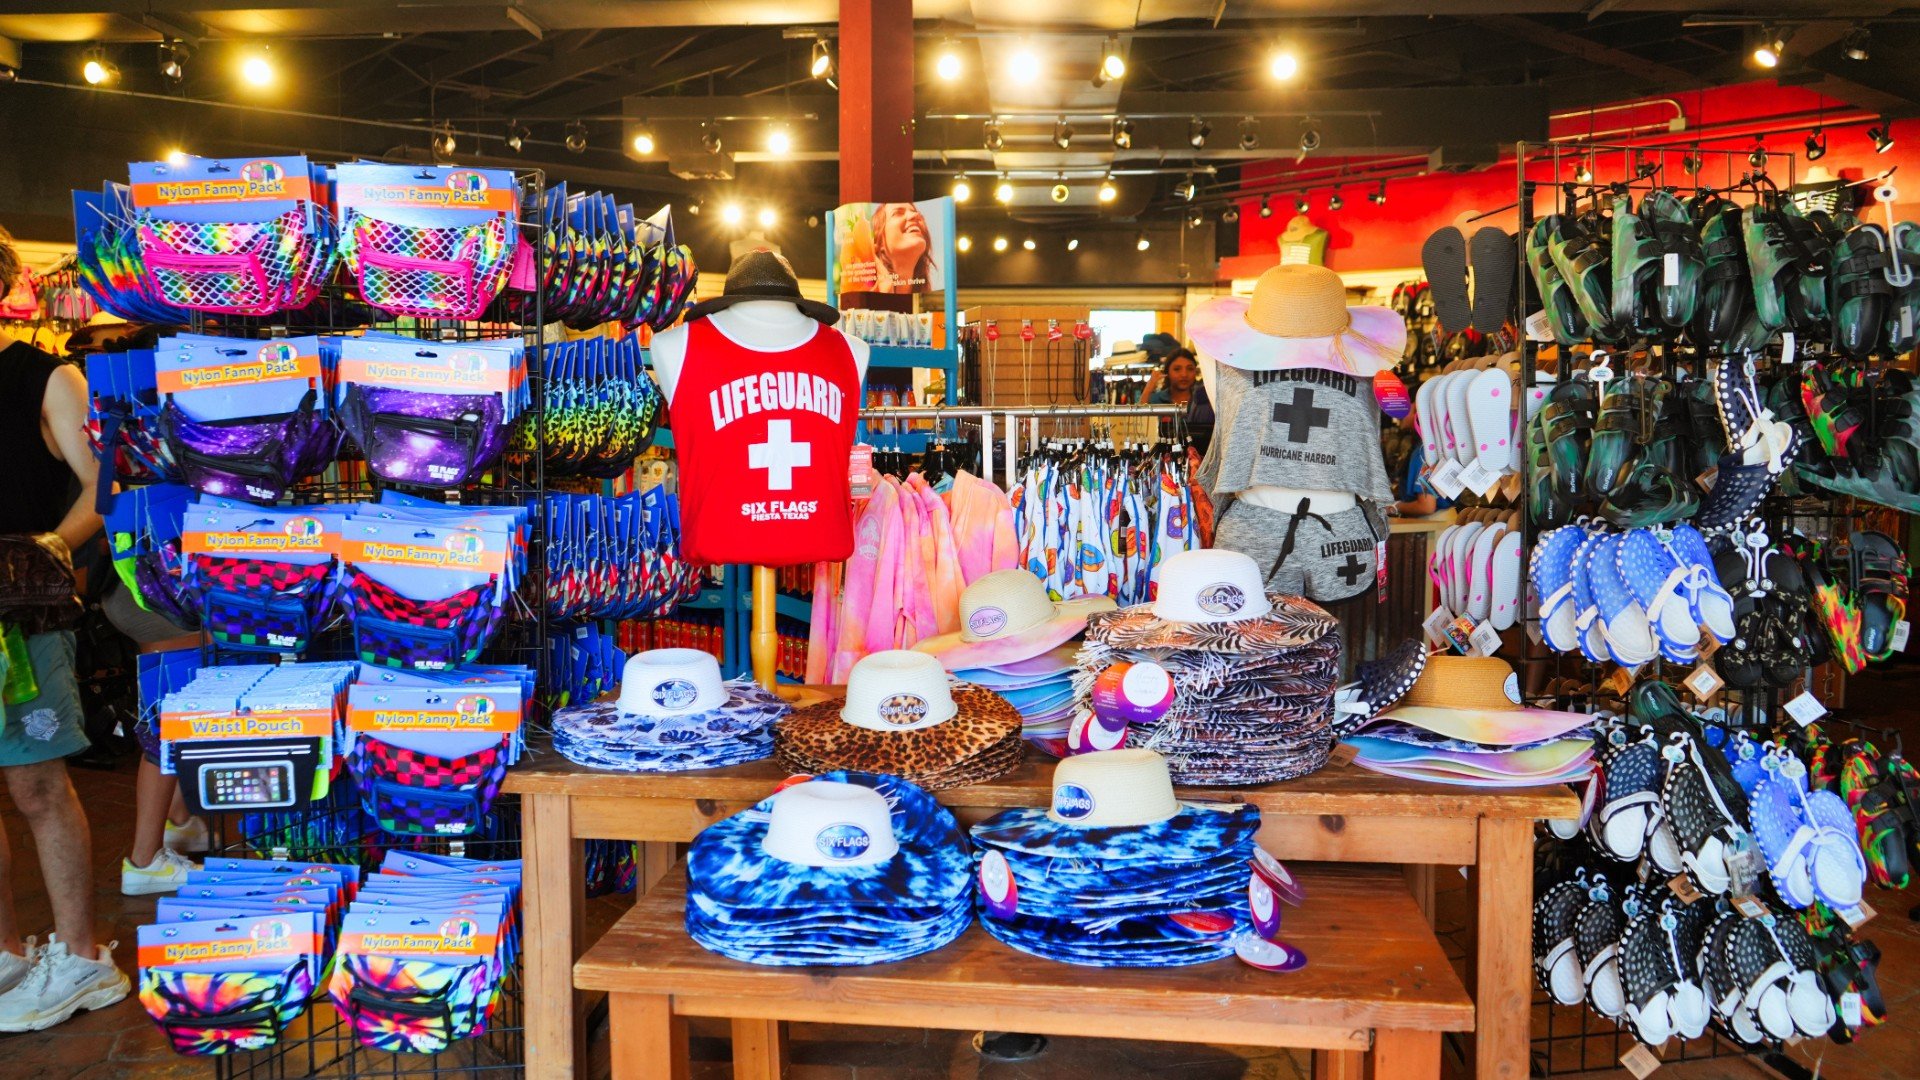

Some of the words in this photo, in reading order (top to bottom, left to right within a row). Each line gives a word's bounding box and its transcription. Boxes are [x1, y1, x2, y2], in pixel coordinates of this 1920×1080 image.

[159, 185, 200, 199] Nylon
[204, 184, 245, 197] Fanny
[249, 182, 282, 193] Pack
[364, 188, 404, 201] Nylon
[409, 189, 449, 203] Fanny
[453, 191, 485, 202] Pack
[183, 370, 221, 384] Nylon
[225, 367, 262, 380] Fanny
[266, 363, 296, 374] Pack
[368, 365, 407, 379] Nylon
[411, 367, 450, 381] Fanny
[454, 370, 485, 382] Pack
[709, 372, 842, 431] LIFEGUARD
[1260, 445, 1303, 461] HURRICANE
[1304, 452, 1337, 466] HARBOR
[741, 502, 766, 516] SIX
[771, 501, 818, 514] FLAGS
[752, 512, 780, 521] FIESTA
[783, 511, 809, 520] TEXAS
[207, 535, 244, 548] Nylon
[249, 536, 286, 548] Fanny
[290, 536, 320, 546] Pack
[366, 545, 403, 559] Nylon
[407, 548, 445, 562] Fanny
[450, 552, 480, 563] Pack
[1201, 596, 1215, 604] SIX
[1217, 595, 1244, 604] FLAGS
[653, 690, 666, 700] SIX
[668, 689, 696, 699] FLAGS
[881, 707, 896, 715] SIX
[897, 705, 925, 714] FLAGS
[192, 720, 241, 733] Waist
[247, 719, 301, 732] Pouch
[376, 713, 414, 727] Nylon
[418, 714, 456, 726] Fanny
[460, 714, 491, 725] Pack
[820, 838, 835, 847] SIX
[837, 836, 869, 847] FLAGS
[167, 945, 207, 960] Nylon
[212, 943, 252, 955] Fanny
[257, 939, 289, 950] Pack
[364, 936, 400, 950] Nylon
[403, 937, 440, 950] Fanny
[443, 937, 472, 948] Pack
